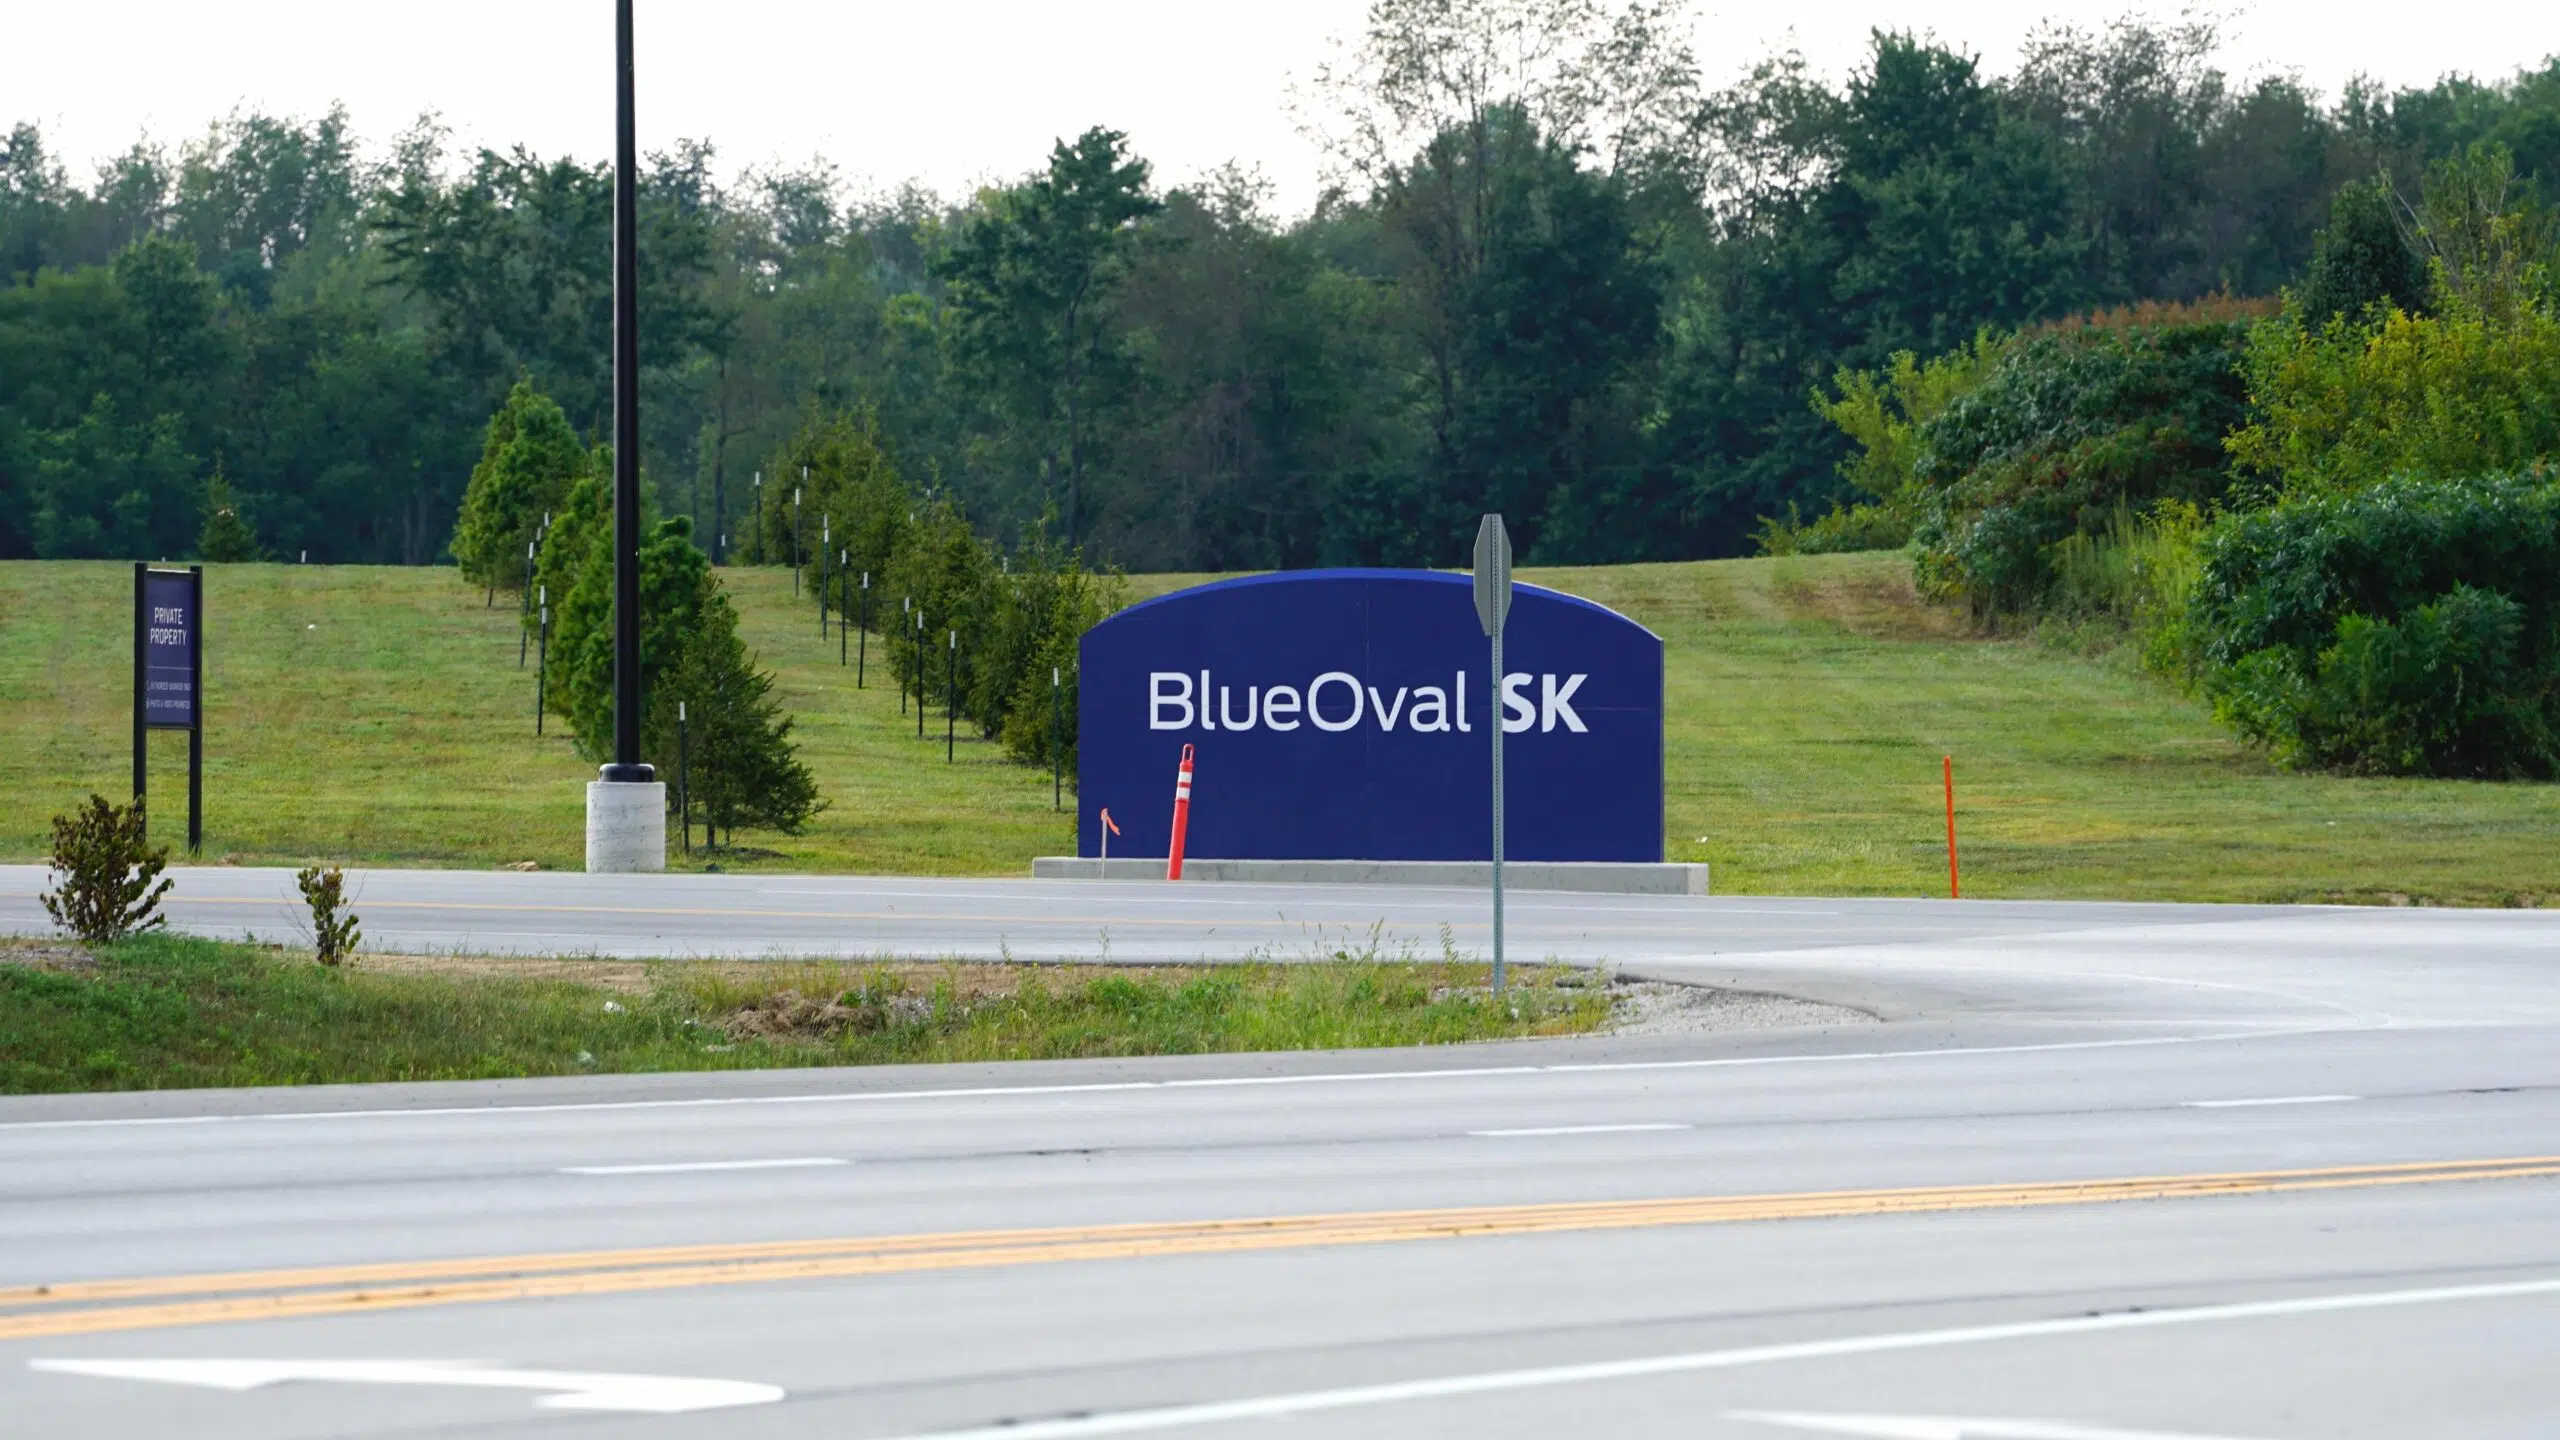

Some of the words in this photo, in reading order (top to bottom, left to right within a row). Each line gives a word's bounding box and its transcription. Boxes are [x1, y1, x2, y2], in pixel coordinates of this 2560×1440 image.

[154, 607, 183, 625] PRIVATE
[150, 628, 187, 646] PROPERTY
[1150, 669, 1471, 732] BlueOval
[1502, 672, 1588, 733] SK
